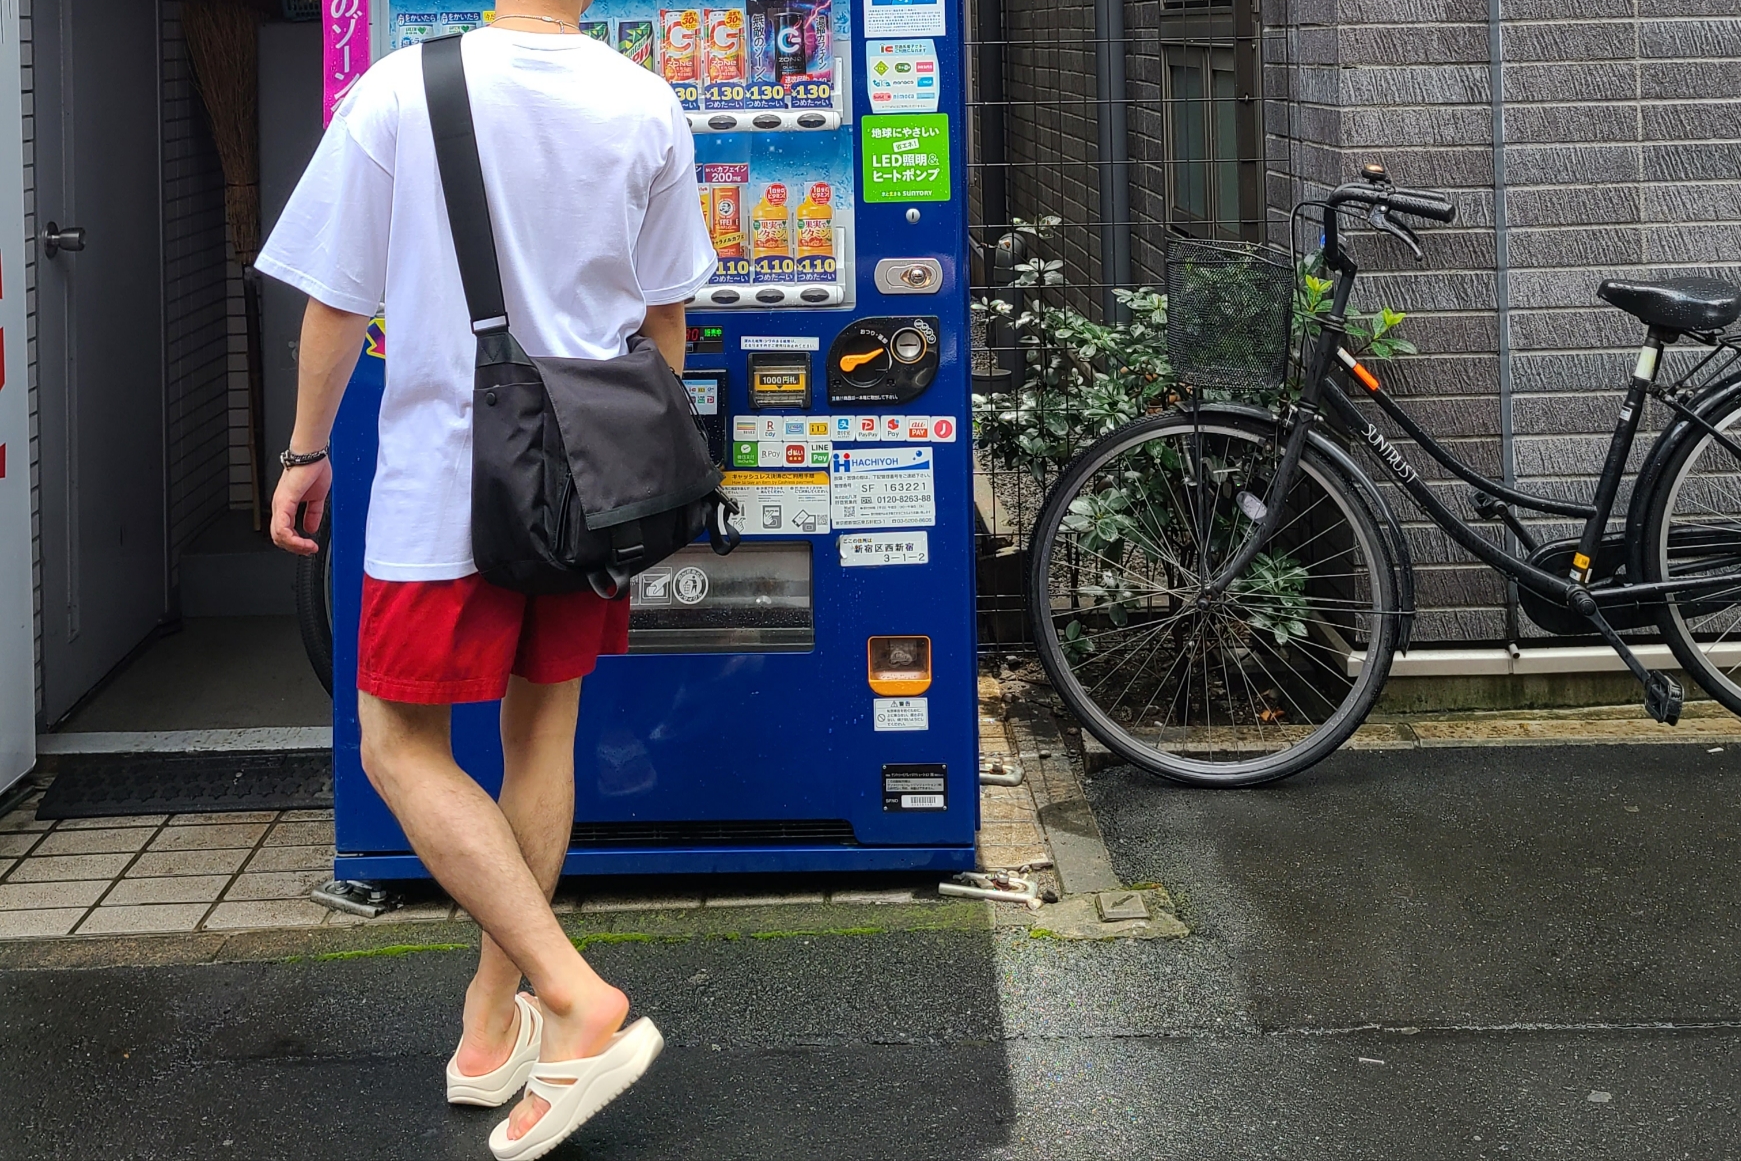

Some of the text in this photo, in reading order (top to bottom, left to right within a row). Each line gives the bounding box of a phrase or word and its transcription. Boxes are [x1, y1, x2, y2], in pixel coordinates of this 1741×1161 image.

[676, 87, 697, 101] 30
[705, 86, 743, 100] ¥130
[745, 85, 784, 100] ¥130
[792, 84, 830, 99] ¥130
[871, 126, 940, 138] 地球にやさしい
[895, 140, 918, 151] 省エネ!
[872, 153, 940, 167] LED照明&
[712, 173, 742, 182] 200mg
[872, 168, 940, 183] ヒートポンプ
[762, 221, 783, 229] 果実で
[806, 220, 827, 229] 果実で
[715, 260, 749, 274] 110
[755, 259, 794, 273] ¥110
[797, 258, 836, 272] ¥110
[768, 450, 781, 458] Pay
[1361, 423, 1419, 484] SUNTRUST
[852, 457, 898, 466] HACHIYOH
[861, 482, 926, 492] SF 163221
[877, 495, 932, 503] 0120-8263-88
[854, 543, 914, 554] 新宿区西新宿
